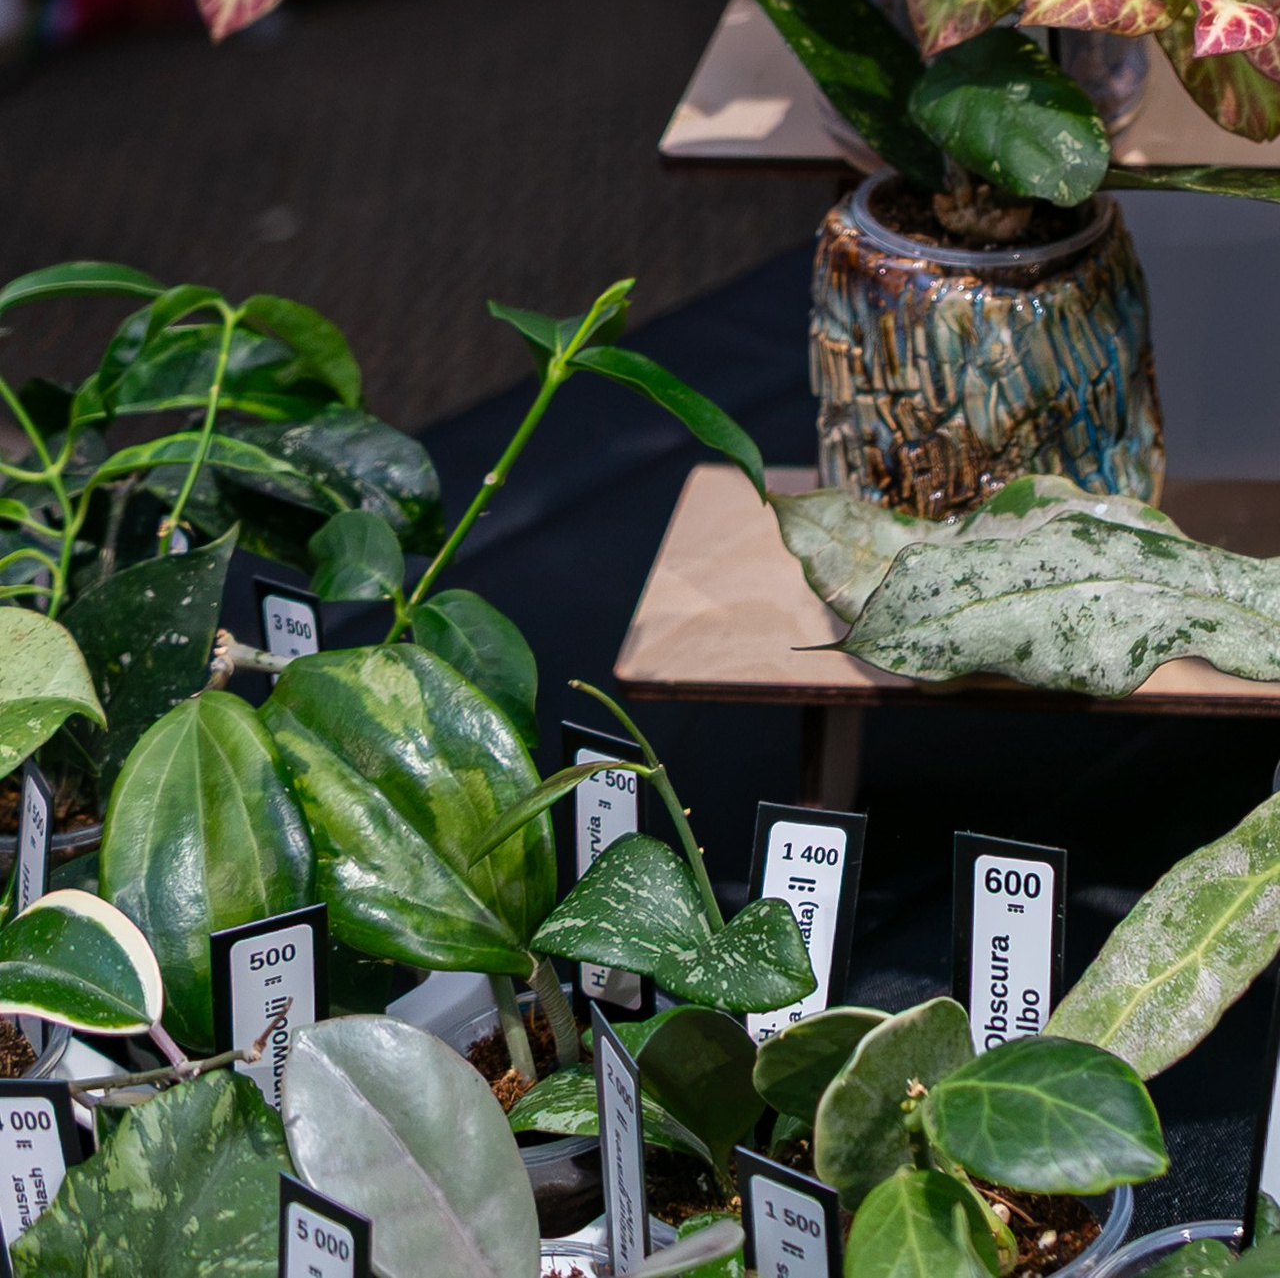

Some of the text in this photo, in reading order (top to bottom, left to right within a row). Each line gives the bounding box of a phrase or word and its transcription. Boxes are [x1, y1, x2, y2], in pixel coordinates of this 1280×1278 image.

[286, 618, 312, 640] 500
[605, 771, 637, 795] 500
[781, 842, 839, 866] 1 400
[984, 867, 1041, 899] 600
[249, 943, 297, 972] 500
[984, 933, 1010, 1053] Obscura
[1015, 988, 1041, 1037] lbo
[10, 1110, 52, 1131] 000
[29, 1166, 48, 1216] lash
[764, 1200, 821, 1238] 1 500
[297, 1218, 349, 1261] 5 000
